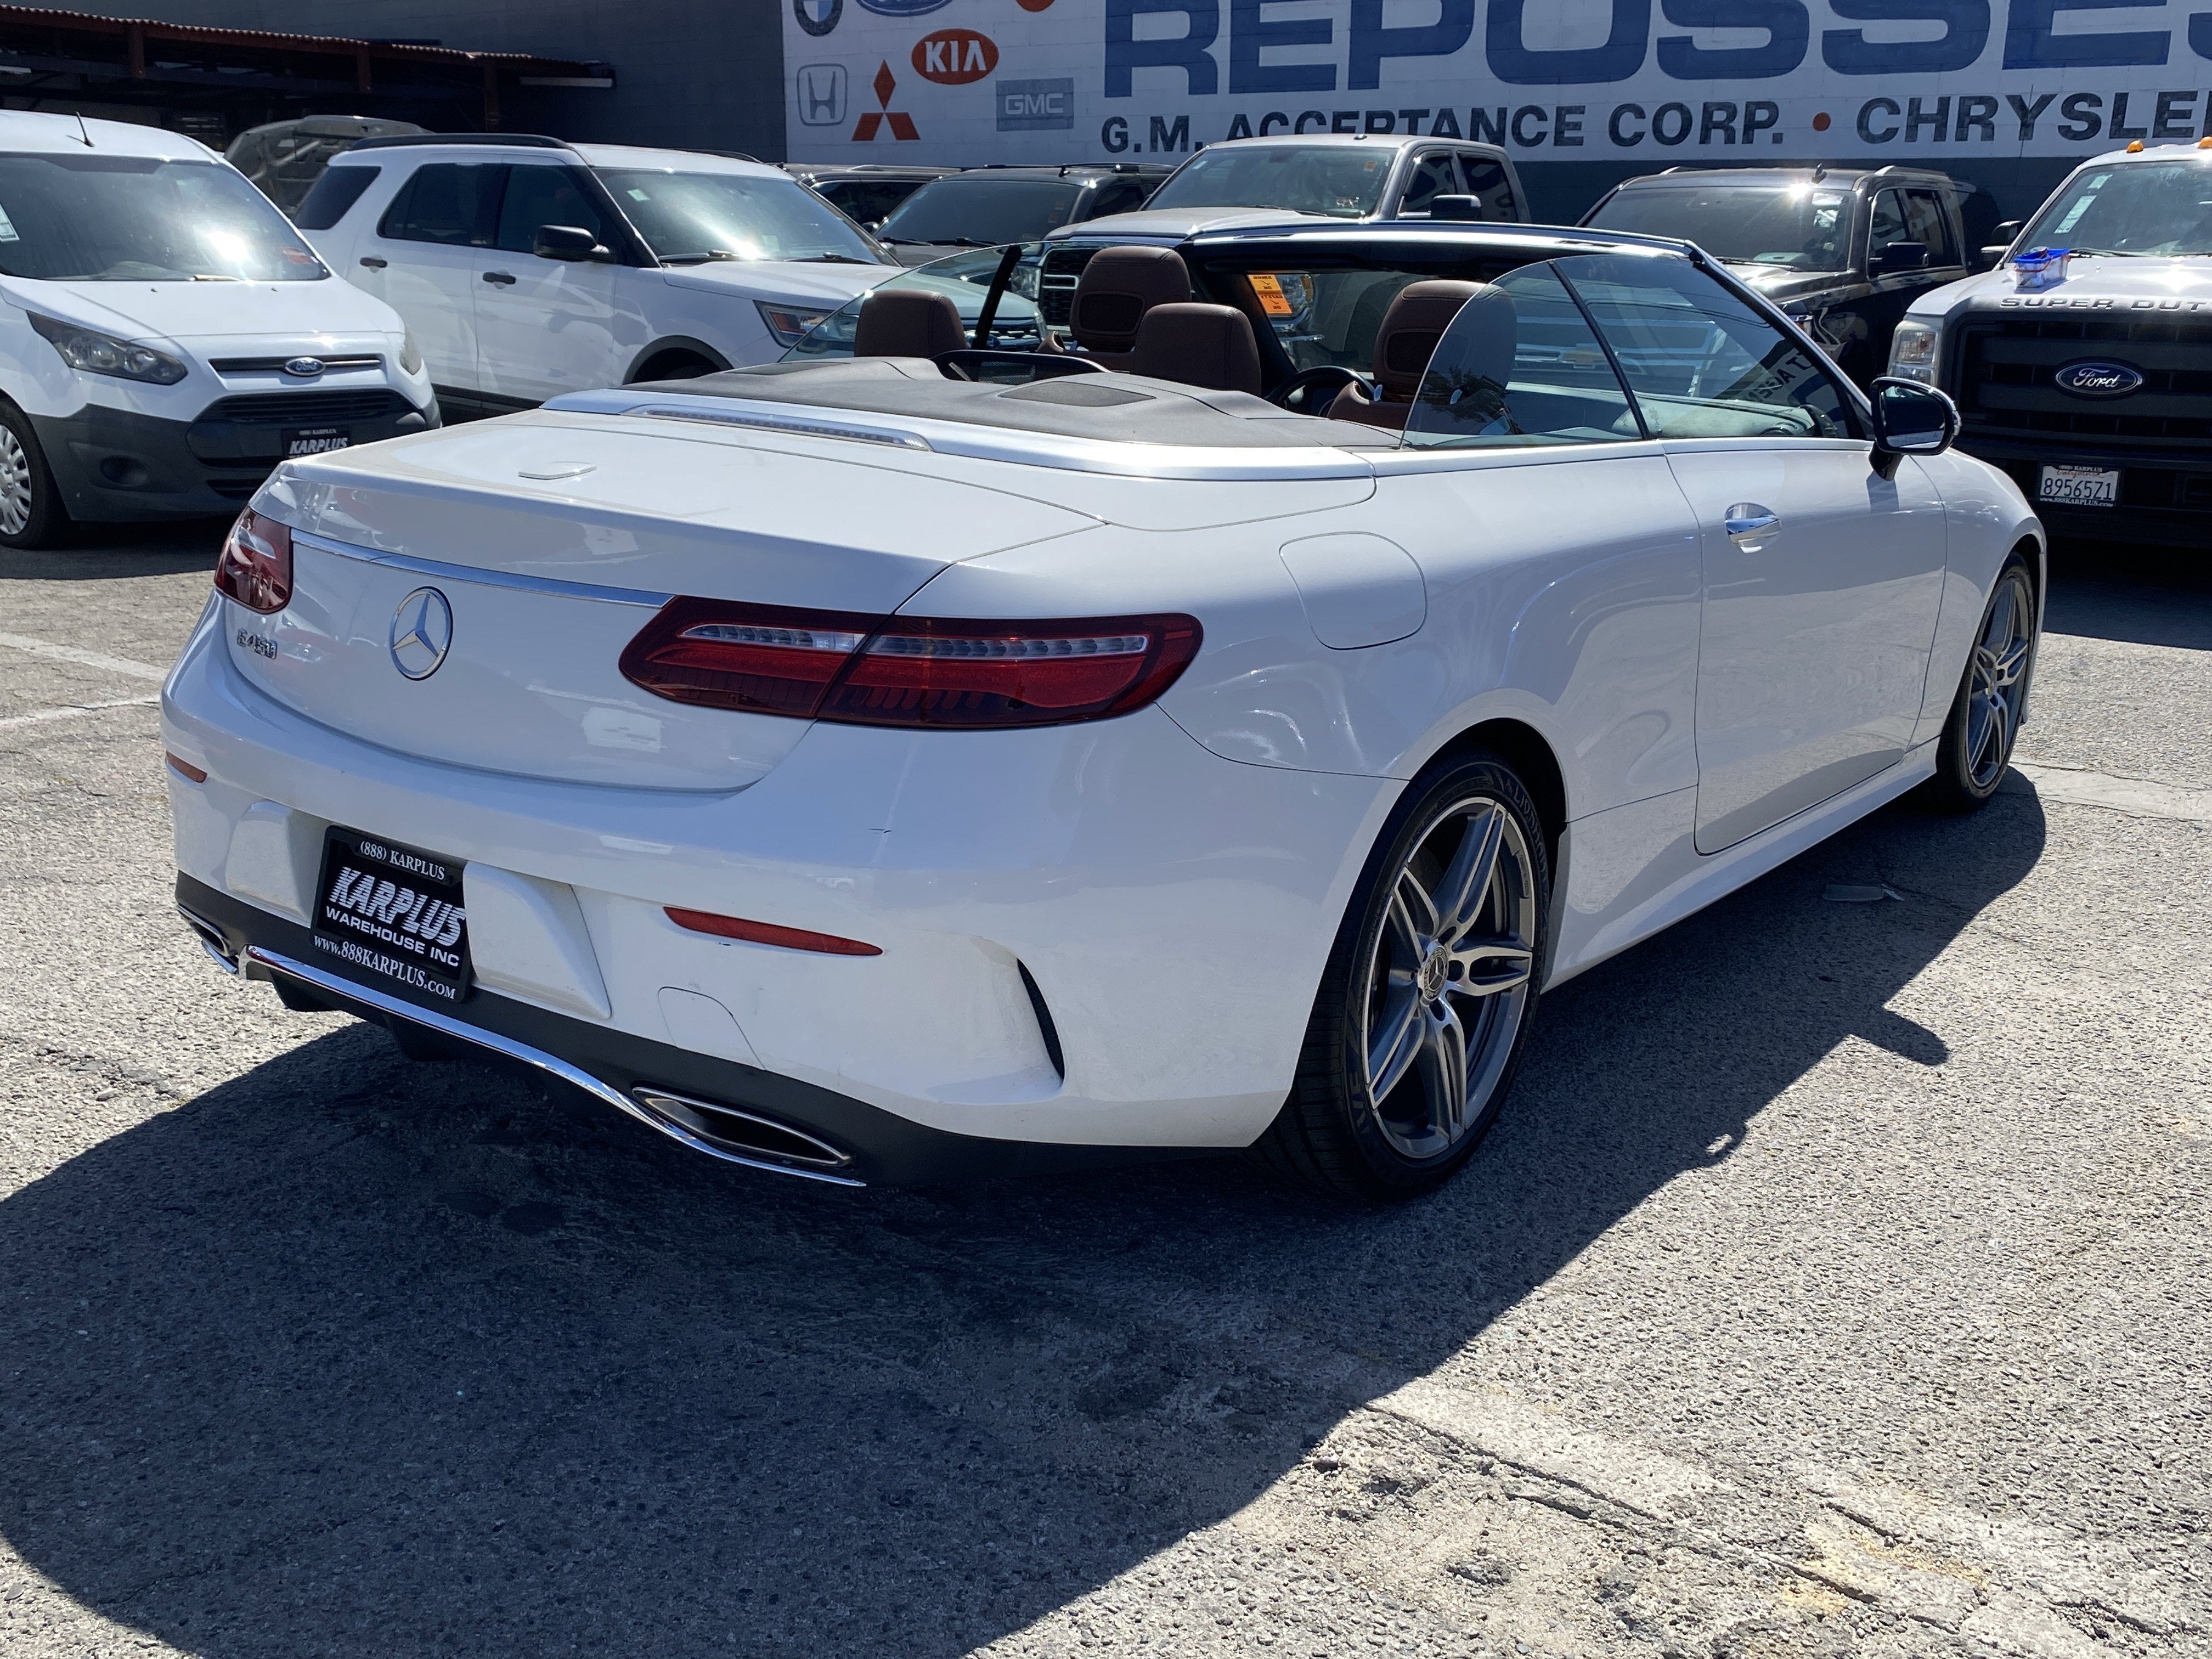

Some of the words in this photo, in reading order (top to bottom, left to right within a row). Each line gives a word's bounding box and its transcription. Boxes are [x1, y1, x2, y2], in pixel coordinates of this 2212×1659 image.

[924, 40, 987, 72] KIA
[1104, 0, 2212, 98] REPOSSE
[1005, 93, 1064, 115] GMC
[1102, 115, 1204, 153] G.M.
[1226, 105, 1585, 147] ACCEPTANCE
[1608, 101, 1784, 147] CORP.
[1857, 90, 2212, 144] CHRYSLE
[2000, 298, 2114, 309] SUPER
[2131, 300, 2212, 312] DUT
[2073, 368, 2121, 388] Ford
[289, 437, 348, 454] KARPLUS
[2044, 477, 2112, 500] 89565Z1
[360, 840, 387, 860] (888)
[390, 850, 445, 881] KARPLUS
[329, 866, 466, 946] KARPLUS
[326, 906, 425, 955] WAREHOUSE
[430, 947, 459, 967] INC
